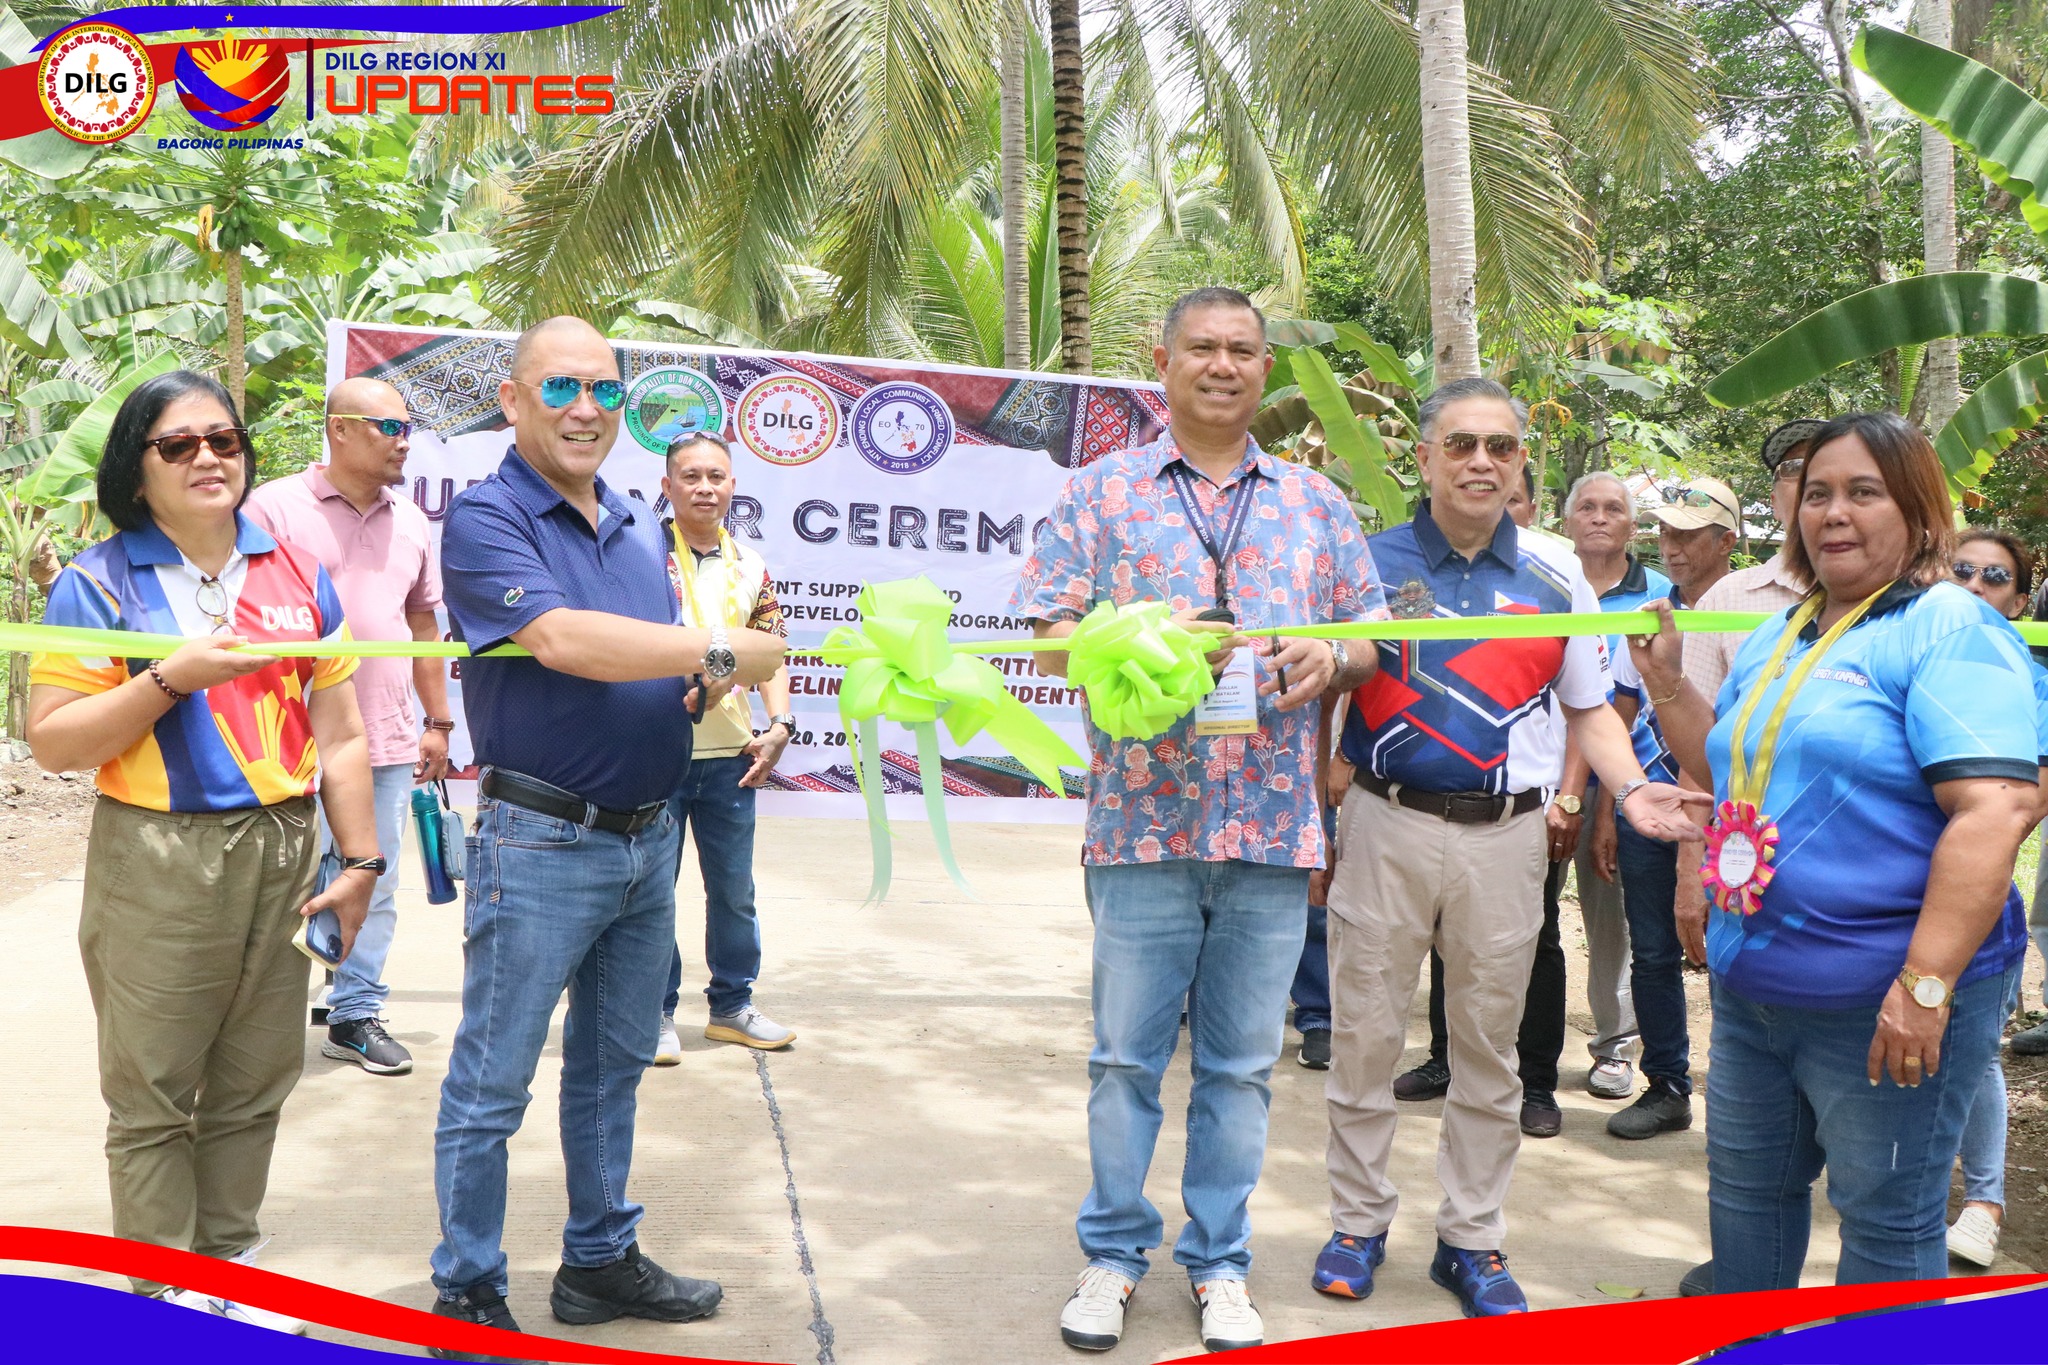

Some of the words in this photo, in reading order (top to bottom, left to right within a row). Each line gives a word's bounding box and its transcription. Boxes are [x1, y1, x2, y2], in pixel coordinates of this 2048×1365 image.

[628, 375, 666, 411] MUNICIPALITY
[667, 373, 678, 383] OF
[678, 374, 694, 387] DON
[693, 379, 719, 416] MARCELINO
[882, 389, 932, 406] COMMUNIST
[861, 397, 883, 419] LOCAL
[928, 405, 945, 431] ARMED
[763, 412, 813, 430] DILG
[632, 416, 653, 445] PROVINCE
[651, 441, 661, 449] OF
[858, 420, 871, 449] ENDING
[866, 449, 882, 462] NTF
[920, 433, 945, 465] CONFLICT
[890, 461, 910, 470] 2018
[1175, 474, 1195, 508] GOVERNANCE
[1190, 506, 1204, 528] SUMMIT
[1199, 527, 1211, 545] 2024
[808, 582, 864, 598] SUPP
[260, 605, 315, 632] DILG
[780, 604, 864, 622] DEVELO
[946, 613, 1030, 631] ROGRAM
[989, 656, 1049, 678] SITI
[788, 675, 843, 696] ELIN
[1003, 685, 1080, 706] IDENT
